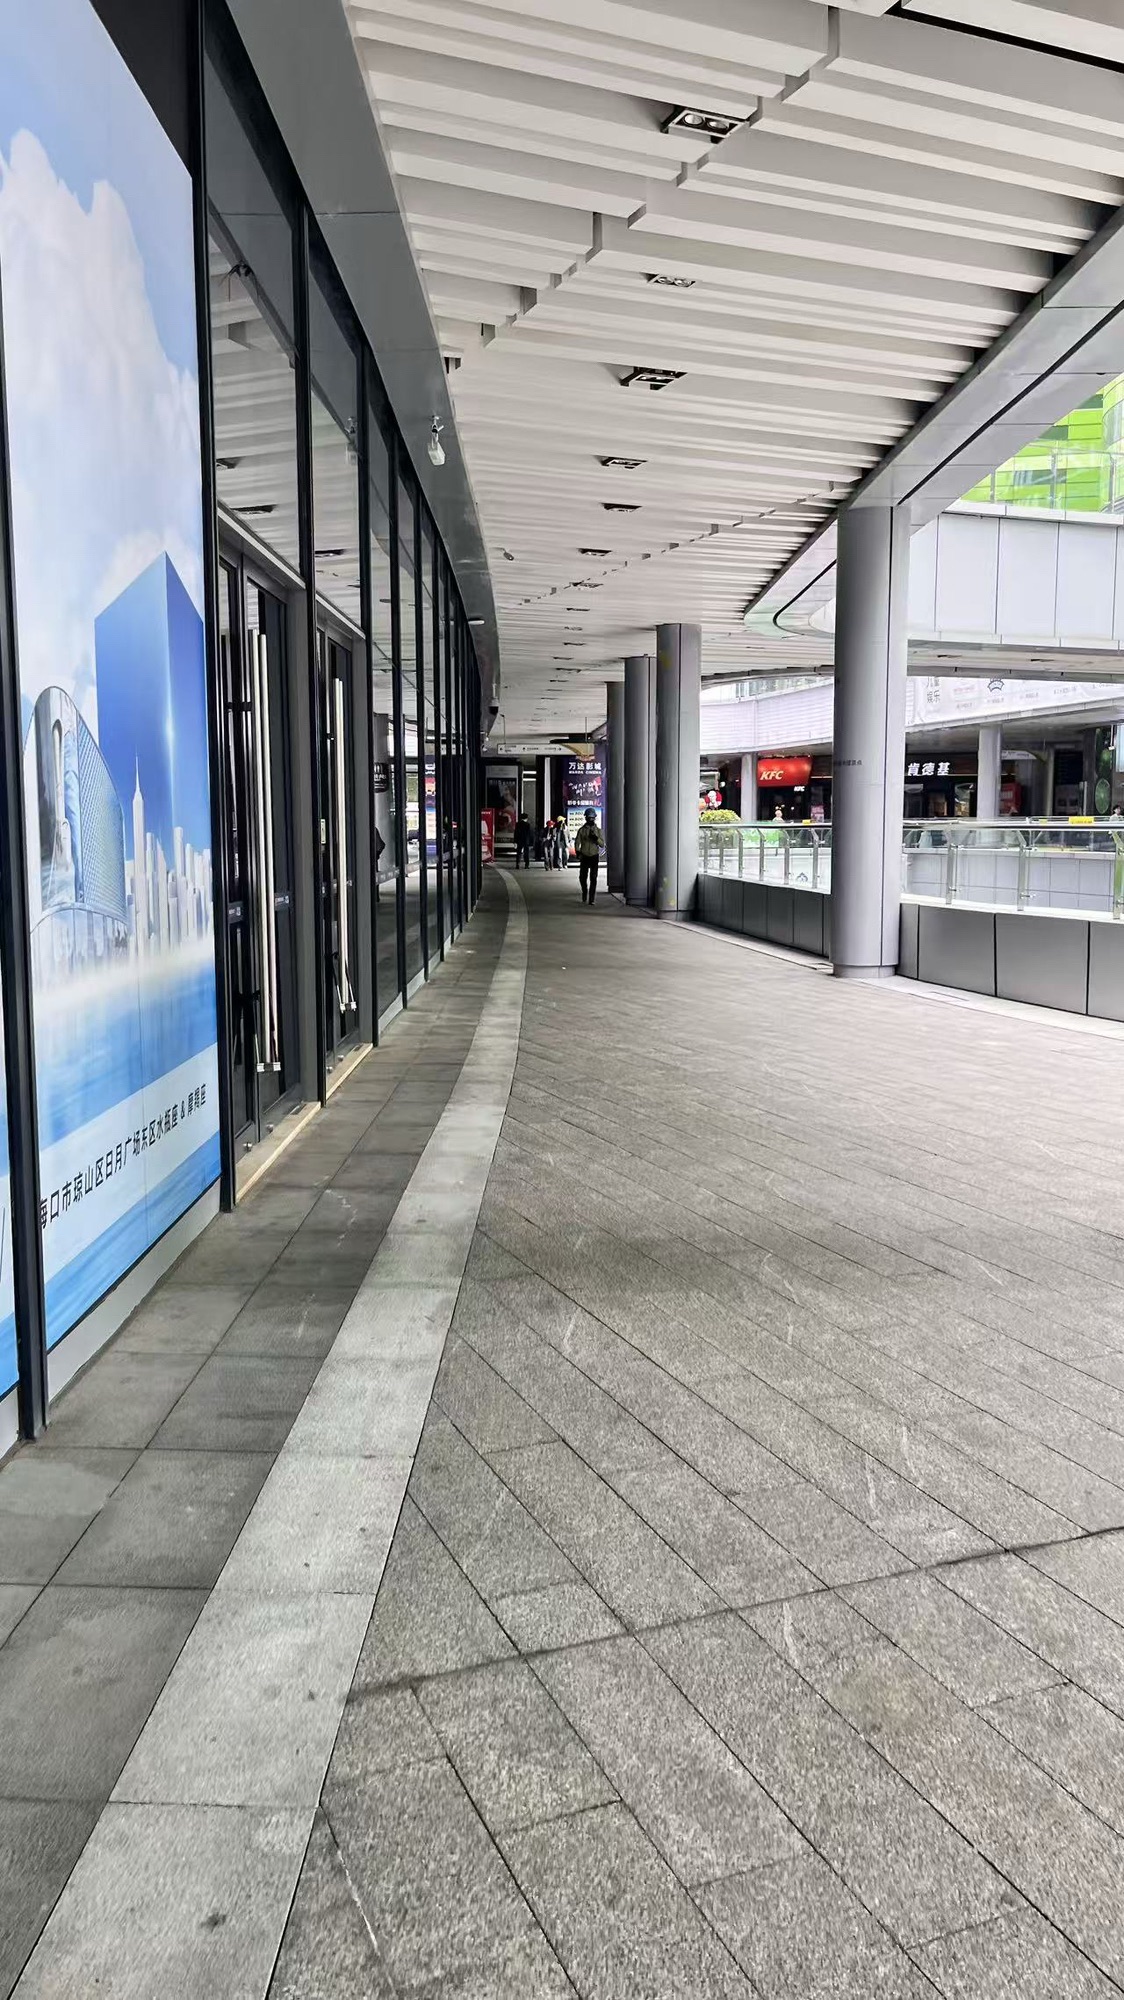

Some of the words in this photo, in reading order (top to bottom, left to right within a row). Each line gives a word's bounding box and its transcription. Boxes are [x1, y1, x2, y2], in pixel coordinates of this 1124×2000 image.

[568, 762, 602, 770] 万达影城
[907, 761, 951, 777] 肯德基
[759, 770, 784, 781] KFC
